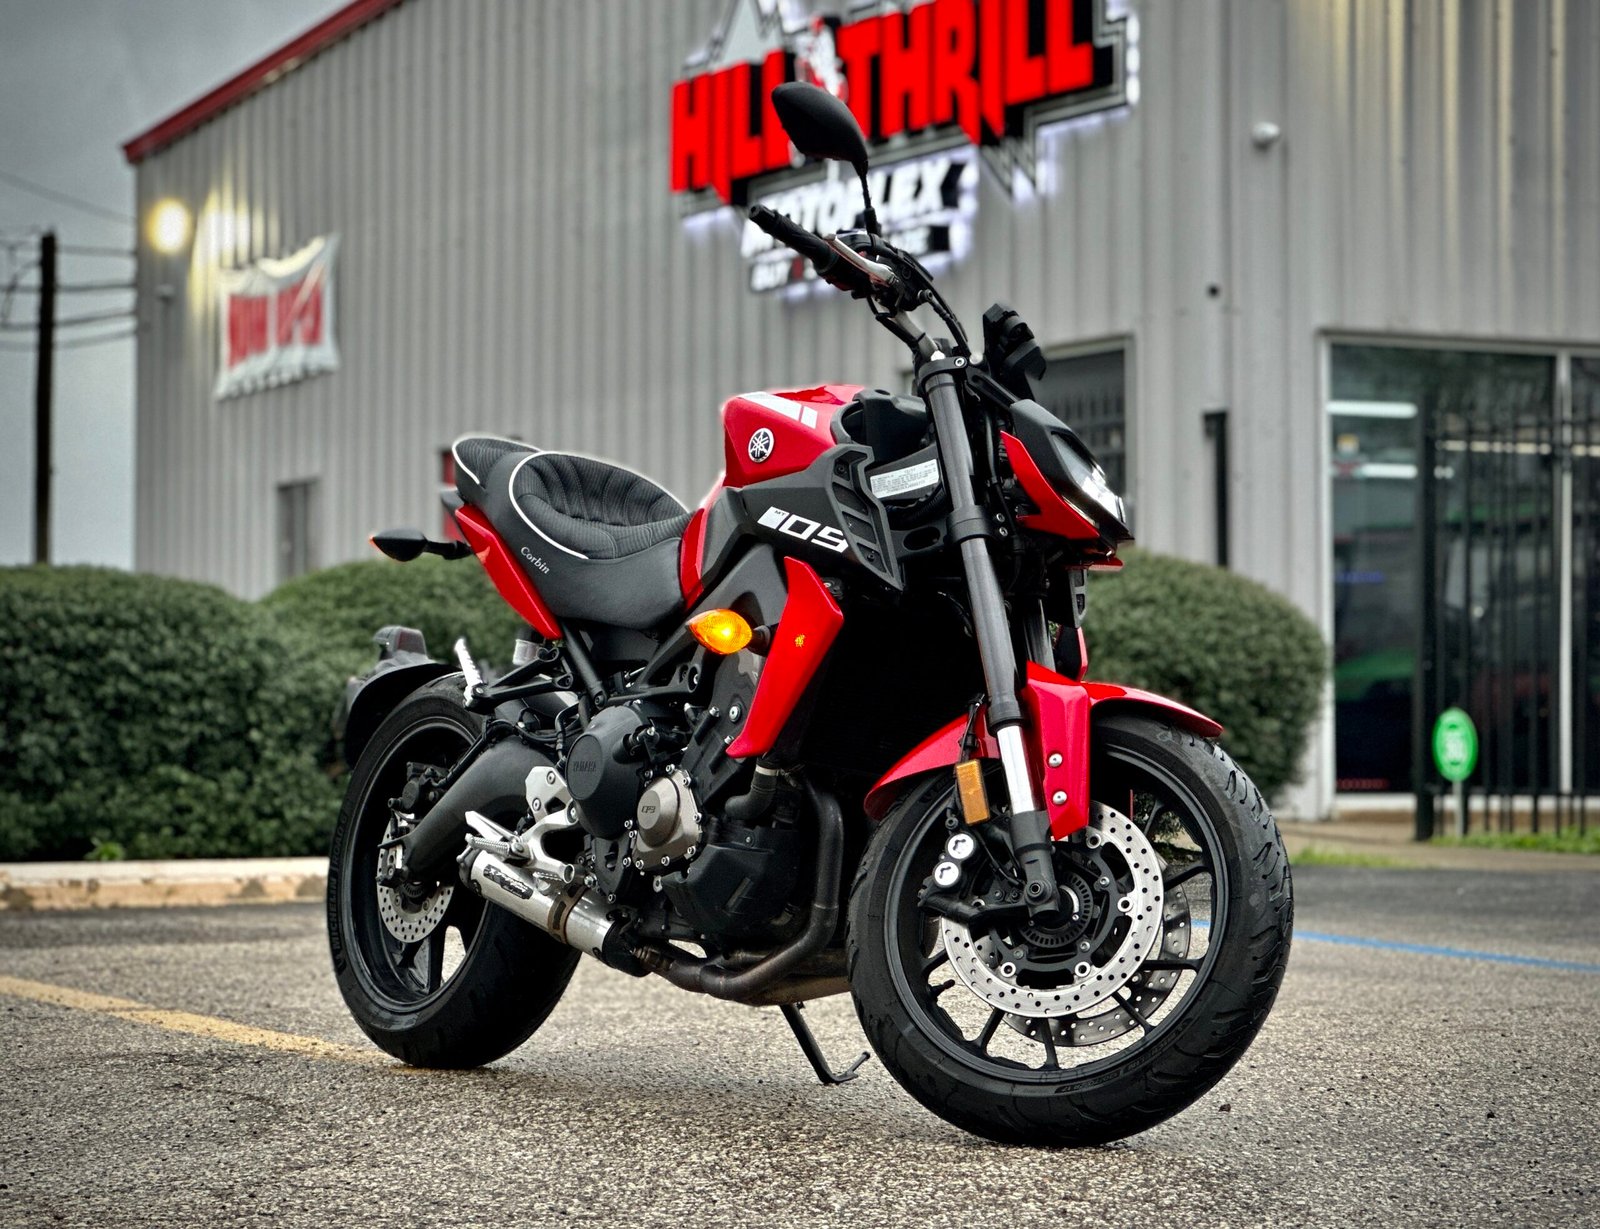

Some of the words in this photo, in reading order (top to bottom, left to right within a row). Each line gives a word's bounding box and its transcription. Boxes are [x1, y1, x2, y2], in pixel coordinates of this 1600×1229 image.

[672, 51, 792, 205] HILL
[837, 0, 1094, 145] THRILL
[520, 546, 550, 574] Corbin
[329, 877, 340, 950] MICHELIN
